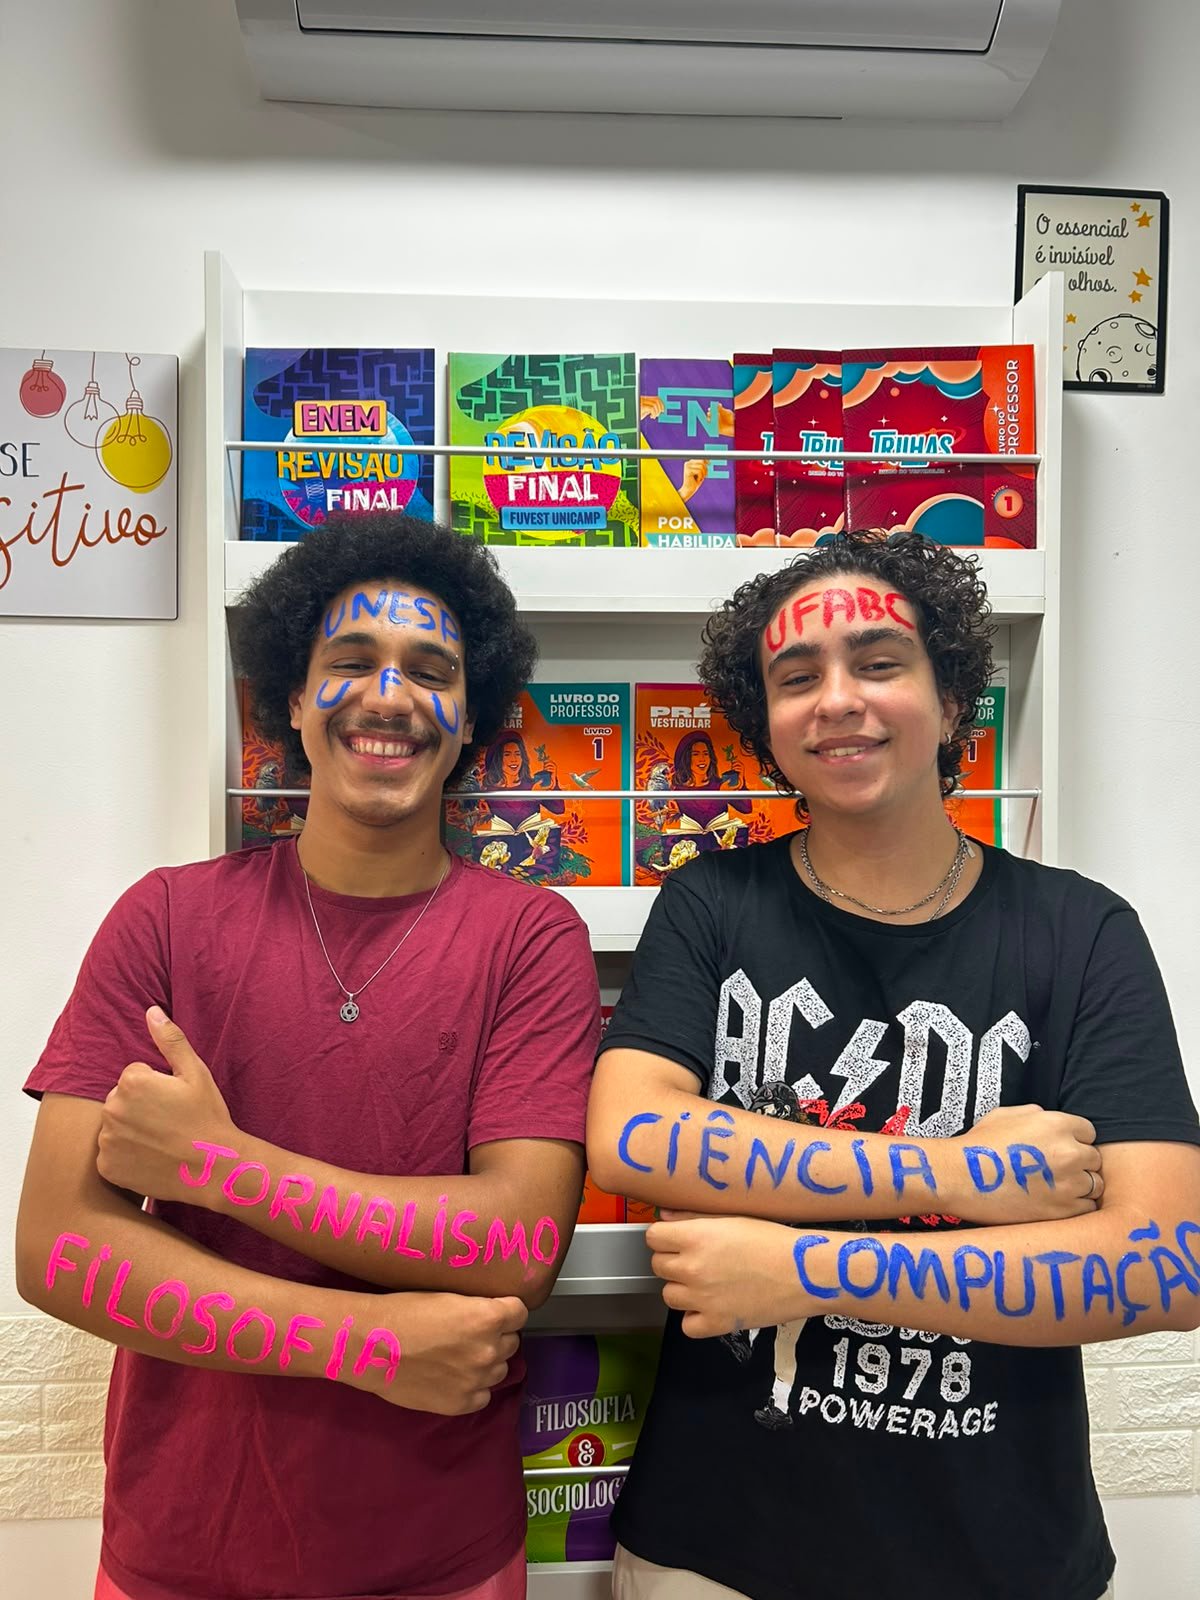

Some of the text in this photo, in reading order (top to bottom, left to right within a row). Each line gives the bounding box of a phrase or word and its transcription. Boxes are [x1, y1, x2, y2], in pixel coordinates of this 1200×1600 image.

[1036, 213, 1129, 239] O essencial
[1035, 245, 1115, 266] é invisível
[1068, 271, 1118, 293] olhos.
[300, 403, 381, 433] ENEM
[326, 487, 404, 511] FINAL
[507, 473, 599, 503] FINAL
[1004, 496, 1013, 512] 1
[510, 511, 600, 525] FUVEST UNICAMP
[658, 517, 695, 530] POR
[324, 589, 460, 643] UNESP
[765, 587, 915, 653] UFABC
[550, 694, 620, 703] LIVRO DO
[550, 705, 620, 718] PROFESSOR
[650, 703, 711, 718] PRÉ
[584, 727, 612, 736] LIVRO
[650, 717, 711, 728] VESTIBULAR
[592, 737, 604, 760] 1
[962, 1143, 1058, 1193] DA
[833, 1337, 972, 1403] 1978
[536, 1394, 636, 1433] FILOSOFIA
[799, 1386, 999, 1440] POWERAGE
